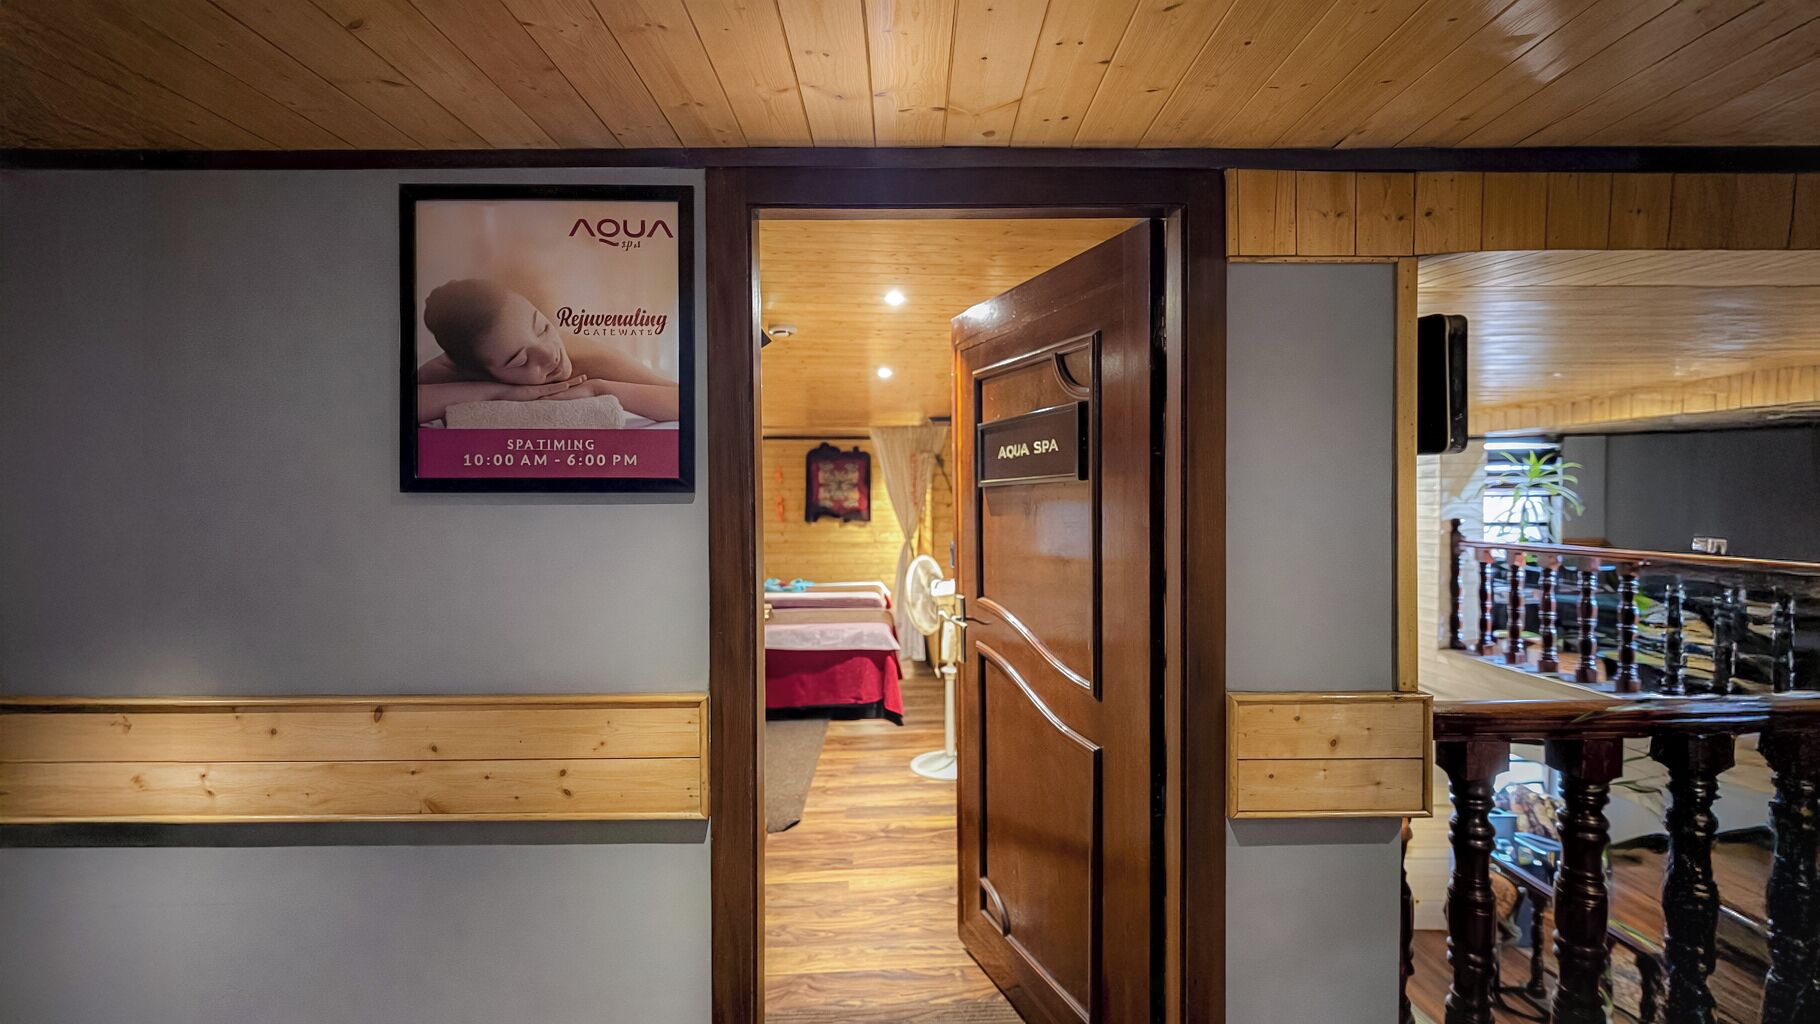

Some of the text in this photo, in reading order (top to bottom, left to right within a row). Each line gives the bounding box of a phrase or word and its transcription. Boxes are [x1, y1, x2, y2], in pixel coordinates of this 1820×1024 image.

[569, 218, 674, 247] AQUA
[621, 240, 641, 252] spa
[556, 306, 668, 335] Rejuvenating
[583, 328, 653, 336] GATEWAYS
[507, 439, 595, 450] SPA TIMING
[997, 438, 1059, 460] AQUA SPA
[463, 454, 514, 466] 10:00
[520, 454, 548, 466] AM
[567, 454, 606, 466] 6:00
[612, 454, 638, 466] PM
